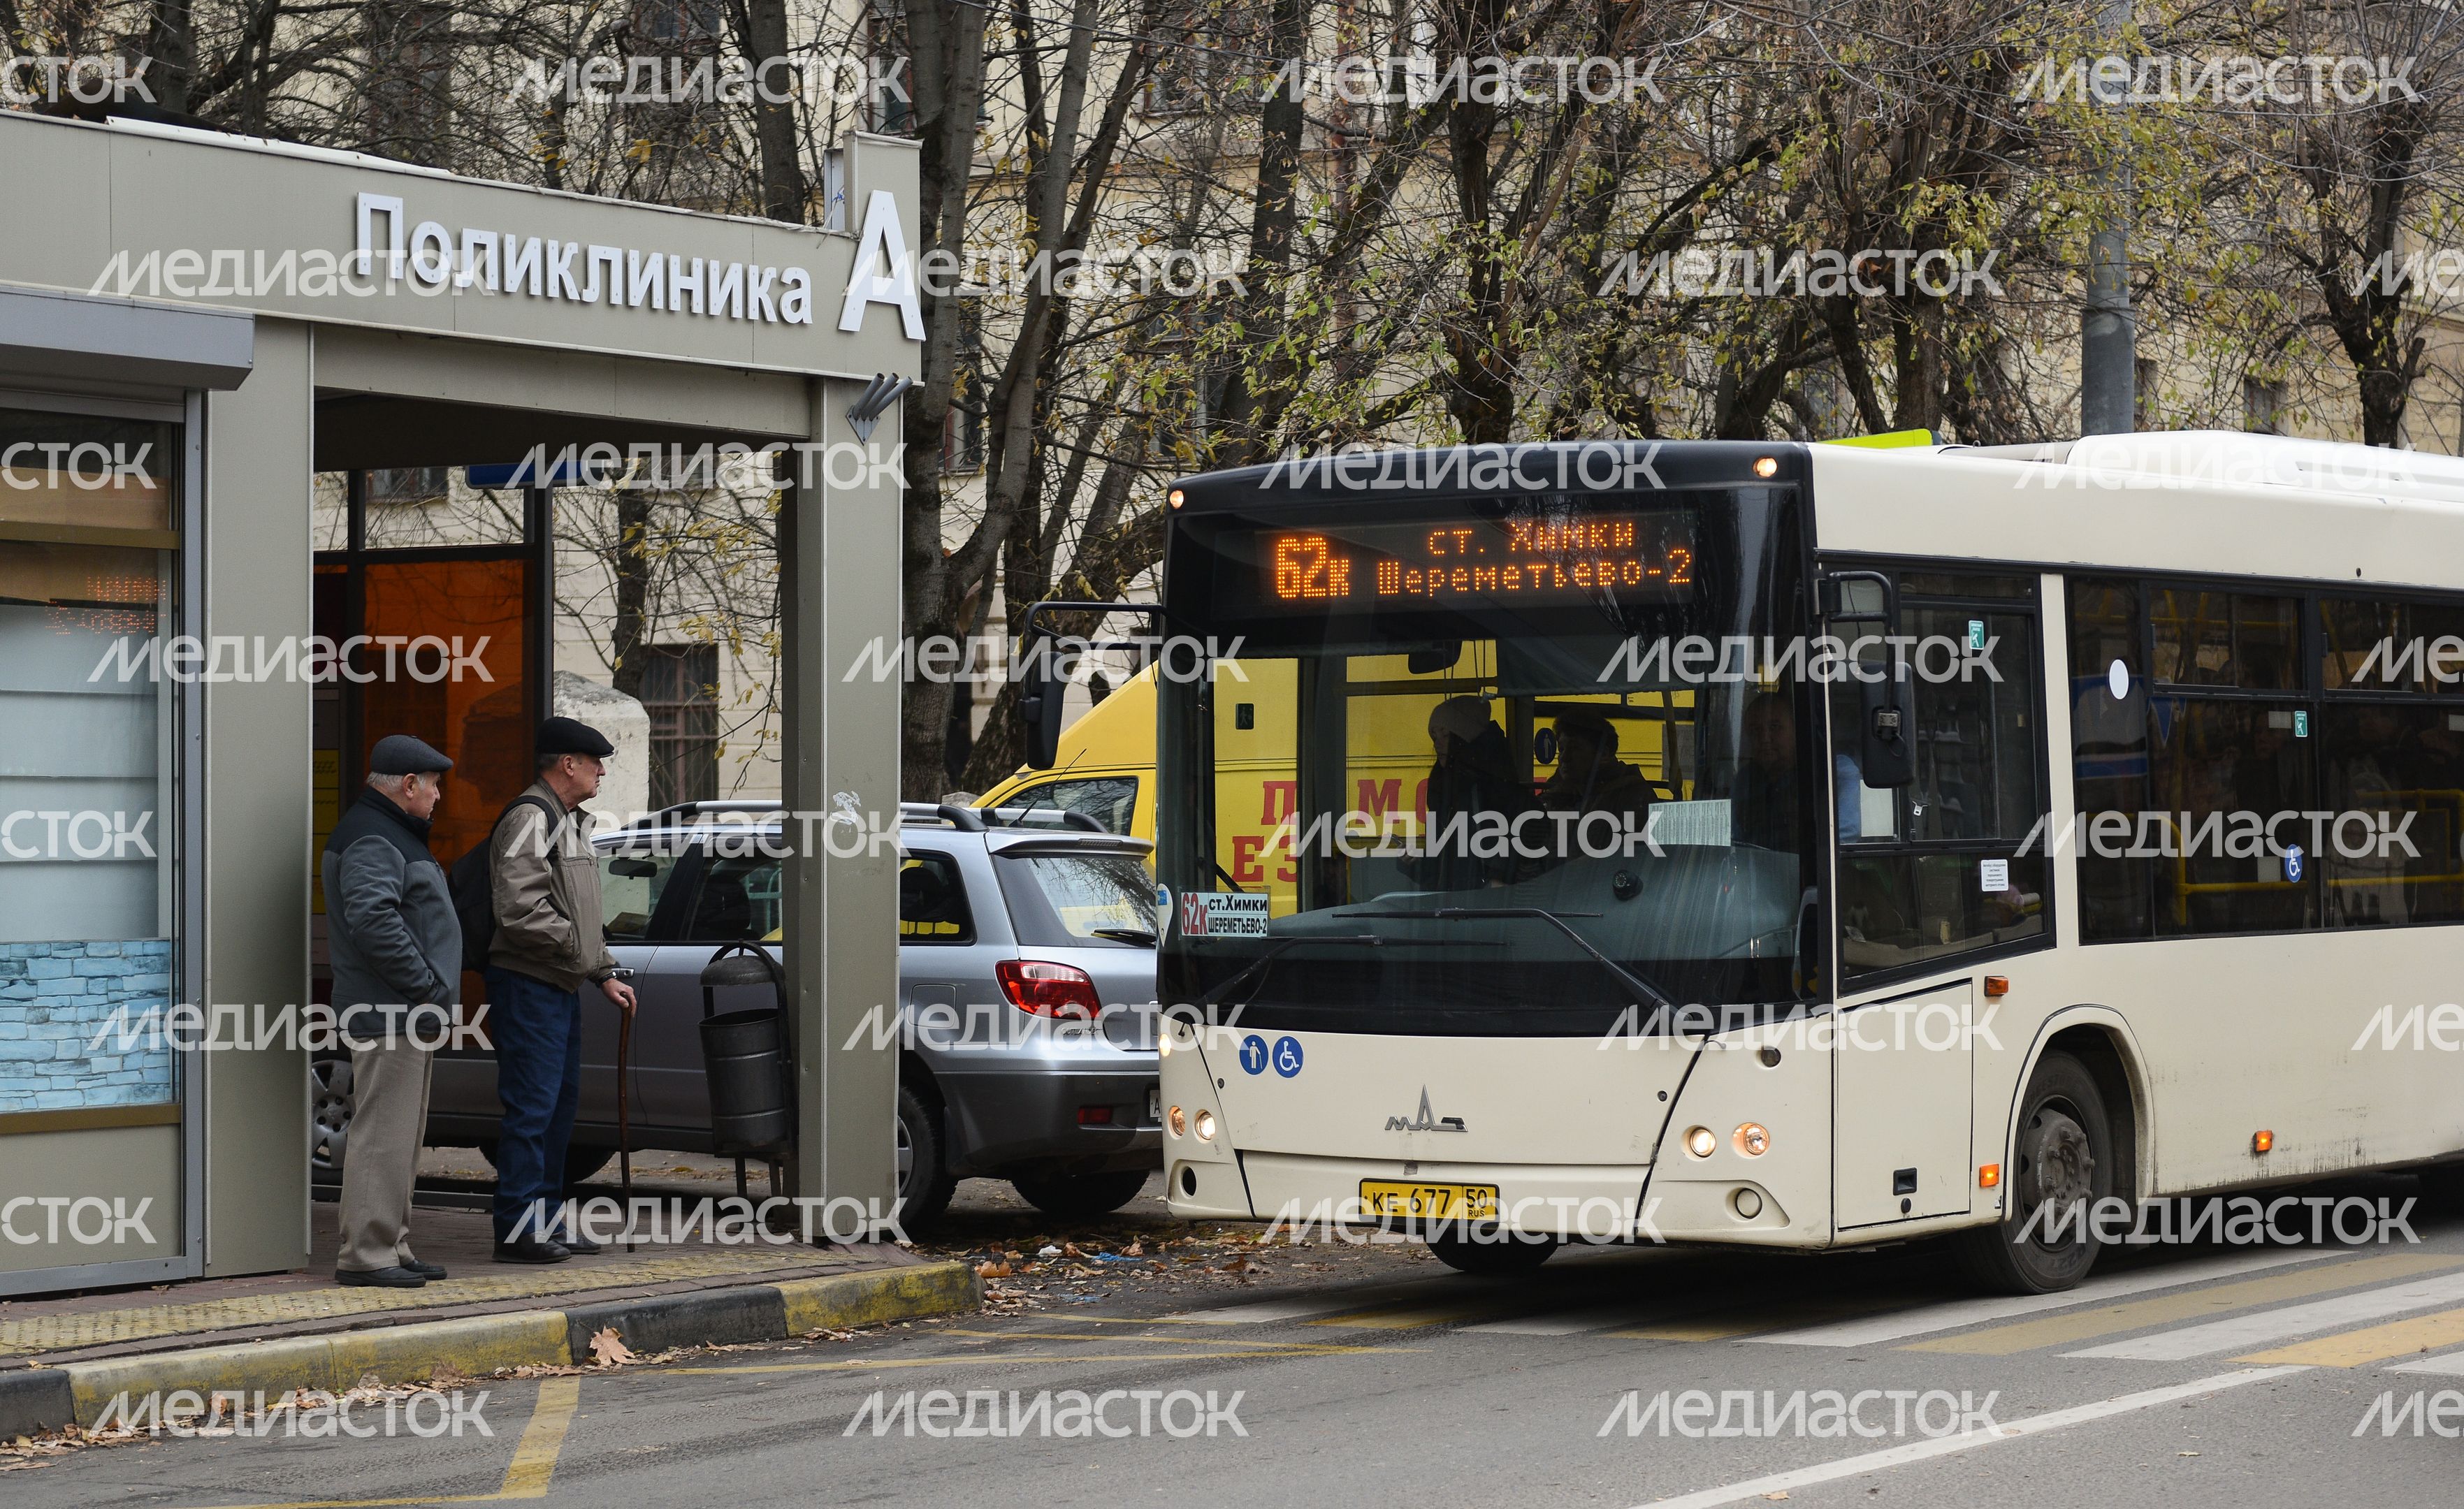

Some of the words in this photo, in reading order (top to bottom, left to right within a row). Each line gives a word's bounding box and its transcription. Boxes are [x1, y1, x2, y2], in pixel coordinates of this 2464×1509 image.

[357, 192, 812, 325] Поликлиника
[839, 190, 927, 341] А
[1512, 522, 1633, 552] Химки
[1377, 548, 1691, 597] Шереметьево-2
[1208, 917, 1267, 934] ШЕРЕМЕТЬЕВО-2
[1409, 1188, 1451, 1215] 677
[1465, 1188, 1488, 1209] 50
[1468, 1209, 1485, 1218] RUS
